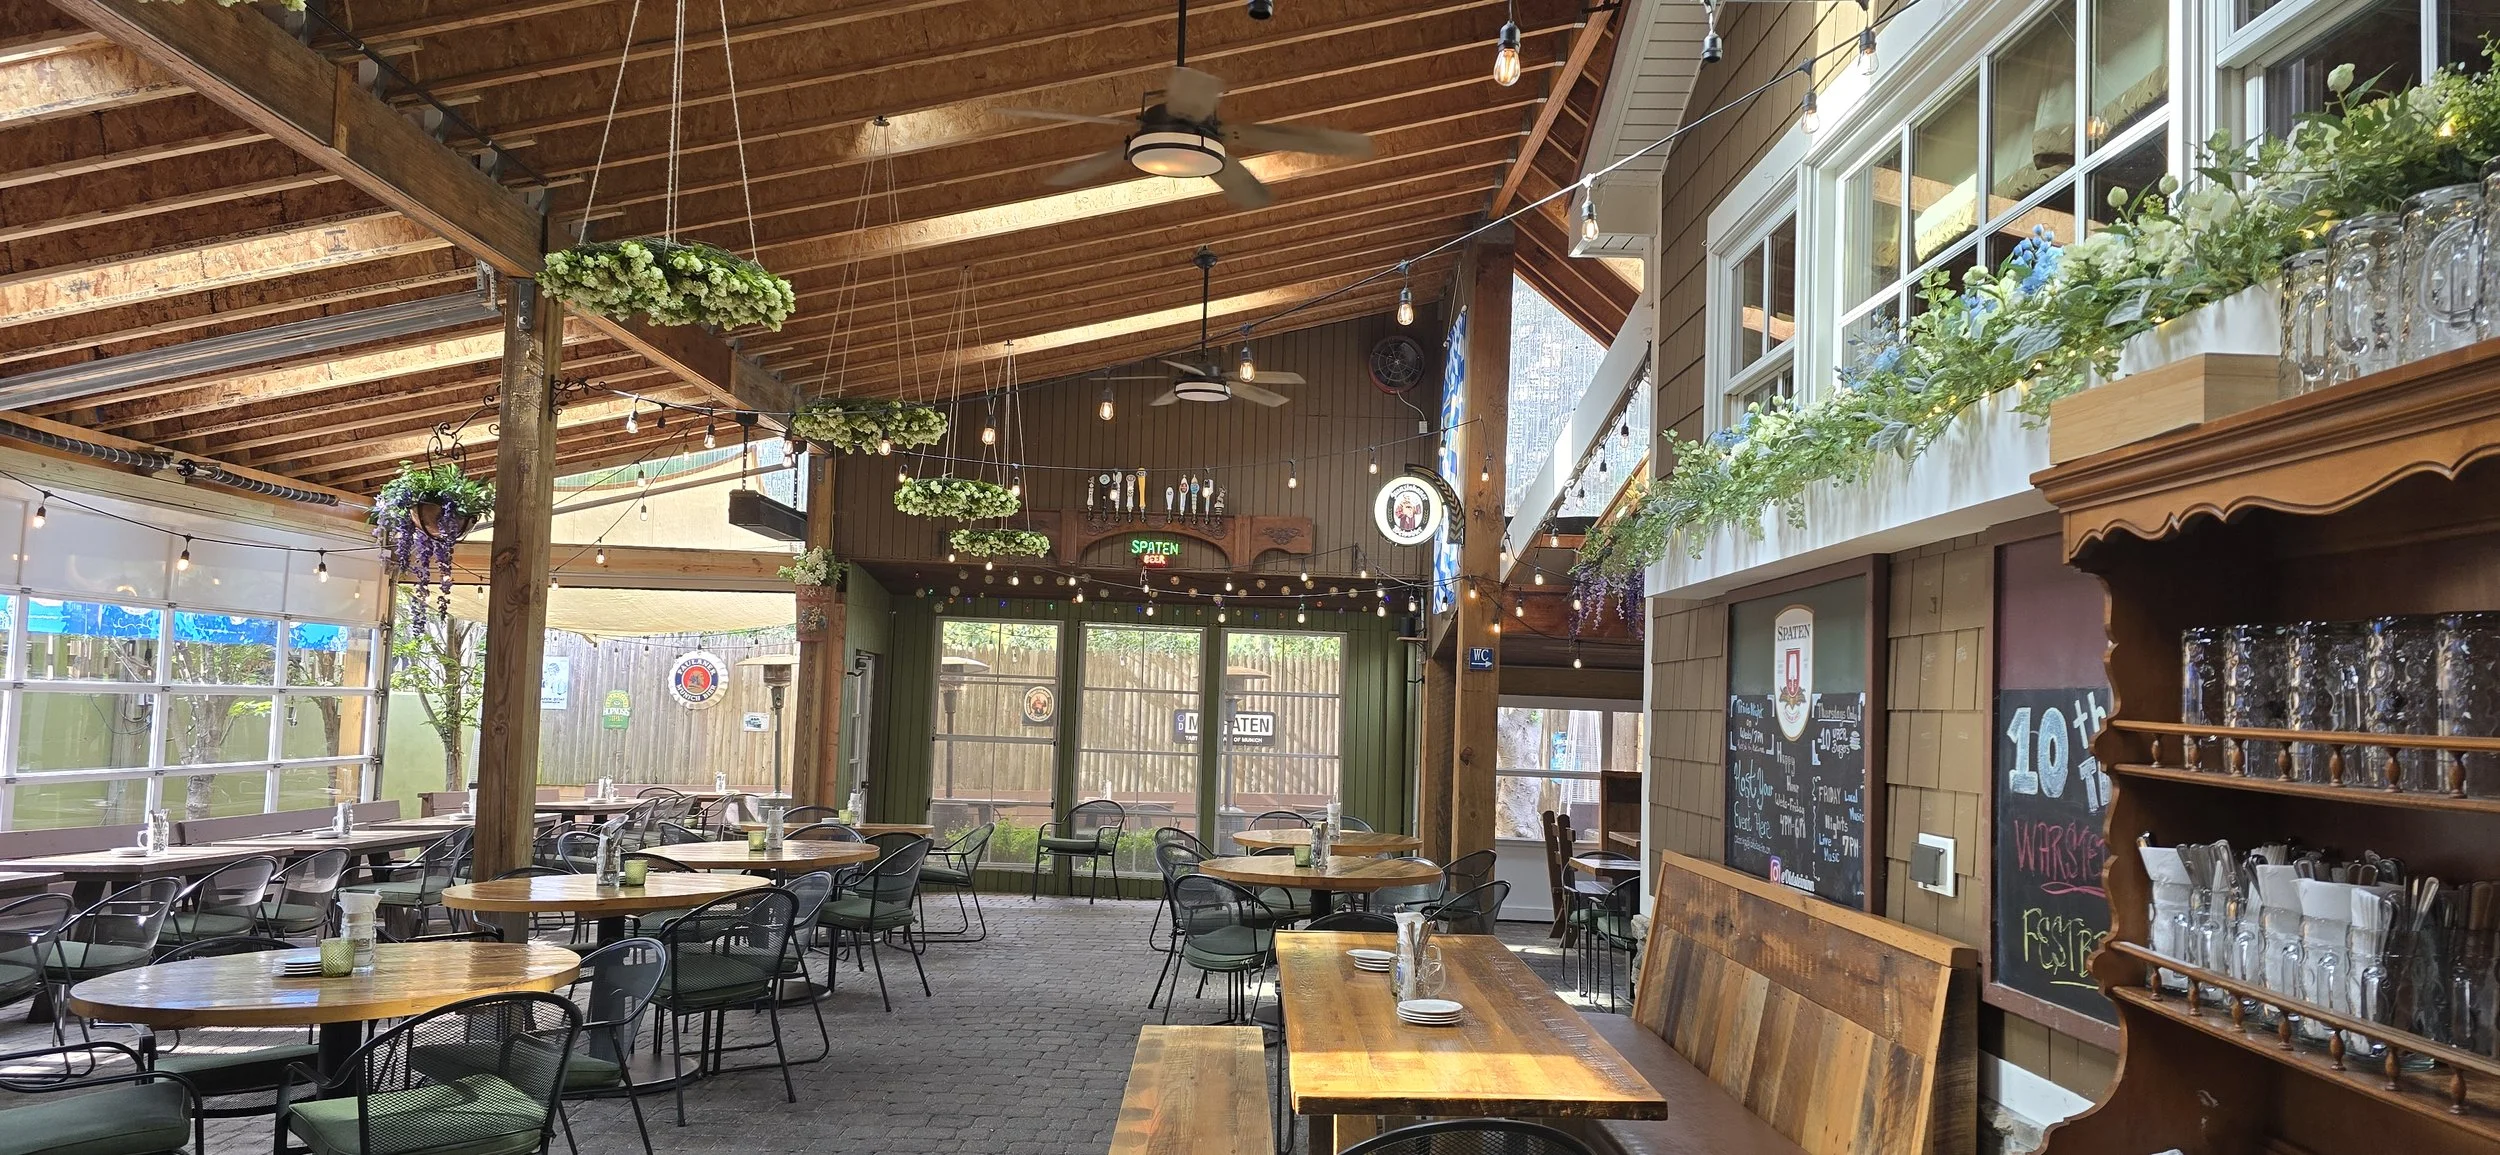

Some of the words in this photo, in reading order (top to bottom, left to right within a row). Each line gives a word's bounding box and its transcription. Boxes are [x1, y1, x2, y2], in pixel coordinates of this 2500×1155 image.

[1131, 540, 1179, 555] SPATEN
[1143, 554, 1166, 564] BEER
[1777, 623, 1811, 641] SPATEN
[1473, 648, 1489, 661] WC
[677, 659, 716, 675] PAULANER
[676, 684, 701, 701] MUNICH
[1817, 703, 1846, 727] Thursdays
[1776, 741, 1796, 777] Happy
[1734, 759, 1756, 808] Host
[1757, 767, 1774, 811] Your
[1786, 775, 1800, 793] Hour
[1818, 786, 1841, 805] FRIDAY
[1844, 789, 1859, 803] Local
[1734, 801, 1753, 832] Event
[1848, 807, 1865, 823] Music
[1825, 814, 1849, 839] Nights
[1818, 833, 1832, 846] Live
[1823, 847, 1840, 863] Music
